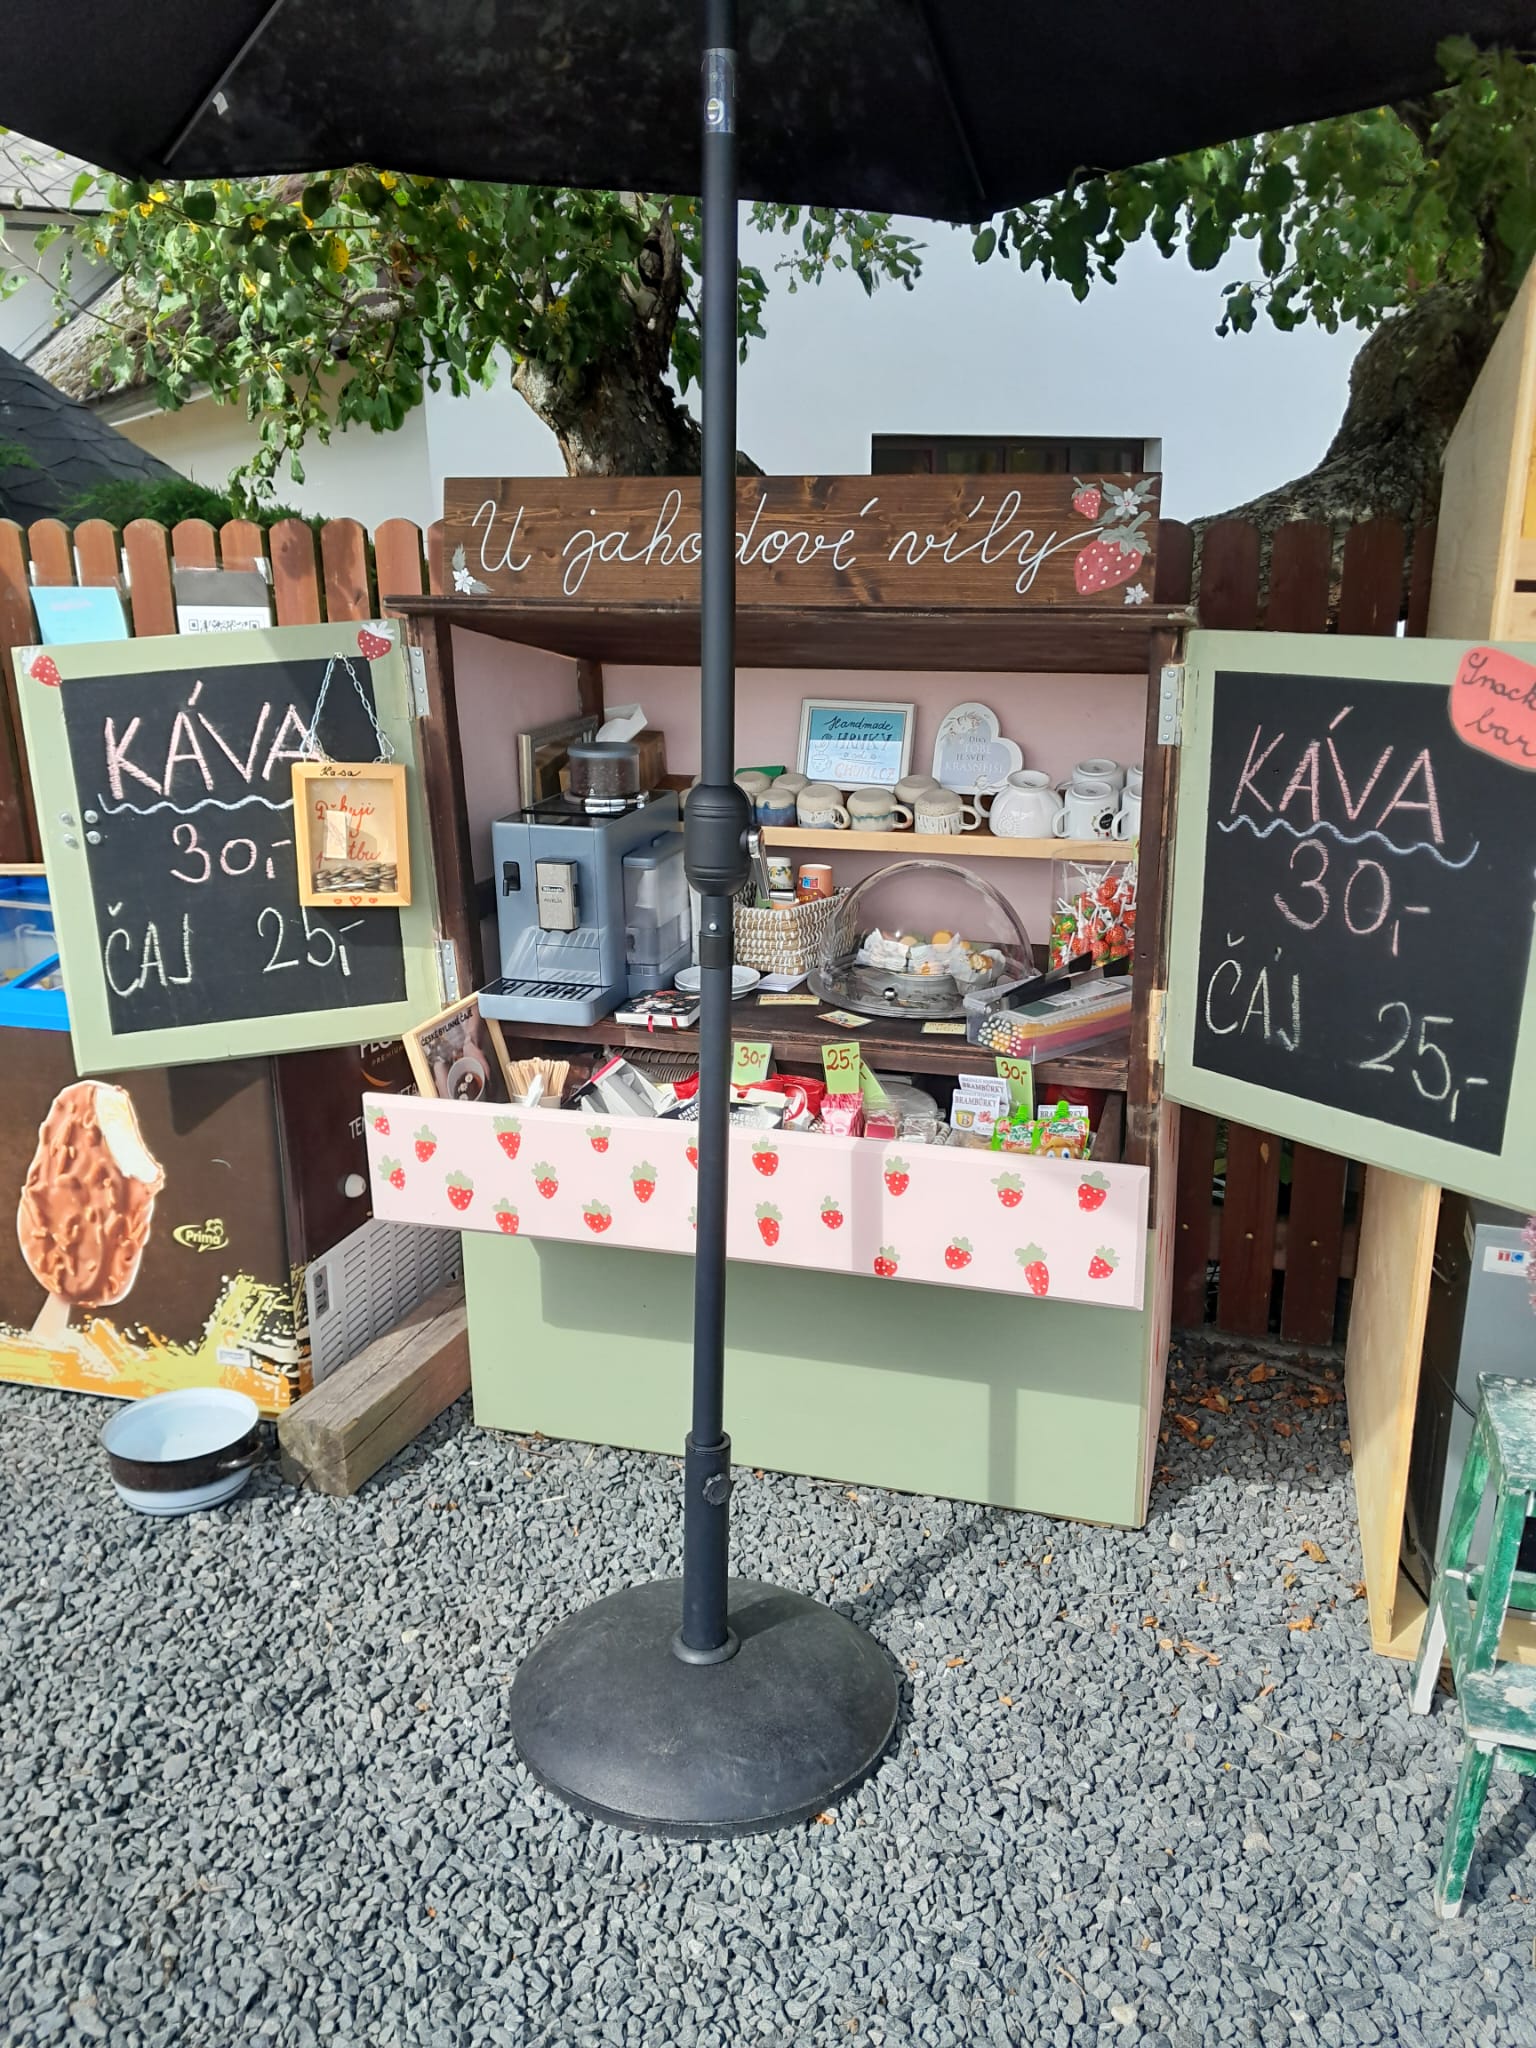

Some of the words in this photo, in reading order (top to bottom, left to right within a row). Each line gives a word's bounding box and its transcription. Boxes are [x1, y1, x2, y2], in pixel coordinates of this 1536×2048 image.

[472, 499, 532, 572] U
[562, 488, 879, 596] jahodové
[887, 489, 1105, 594] víly
[104, 679, 325, 801] KÁVA
[823, 715, 894, 731] Handmade
[1463, 706, 1536, 758] bar
[320, 766, 361, 777] Kasa
[1230, 705, 1446, 844] KÁVA
[170, 823, 292, 884] 30,-
[1274, 838, 1431, 957] 30,-
[105, 901, 193, 998] ČAJ
[257, 907, 365, 977] 25,-
[737, 1046, 766, 1070] 30,-
[826, 1048, 859, 1071] 25,-
[999, 1061, 1028, 1085] 30,-
[1359, 1001, 1489, 1123] 25,-
[186, 1228, 221, 1245] Prima
